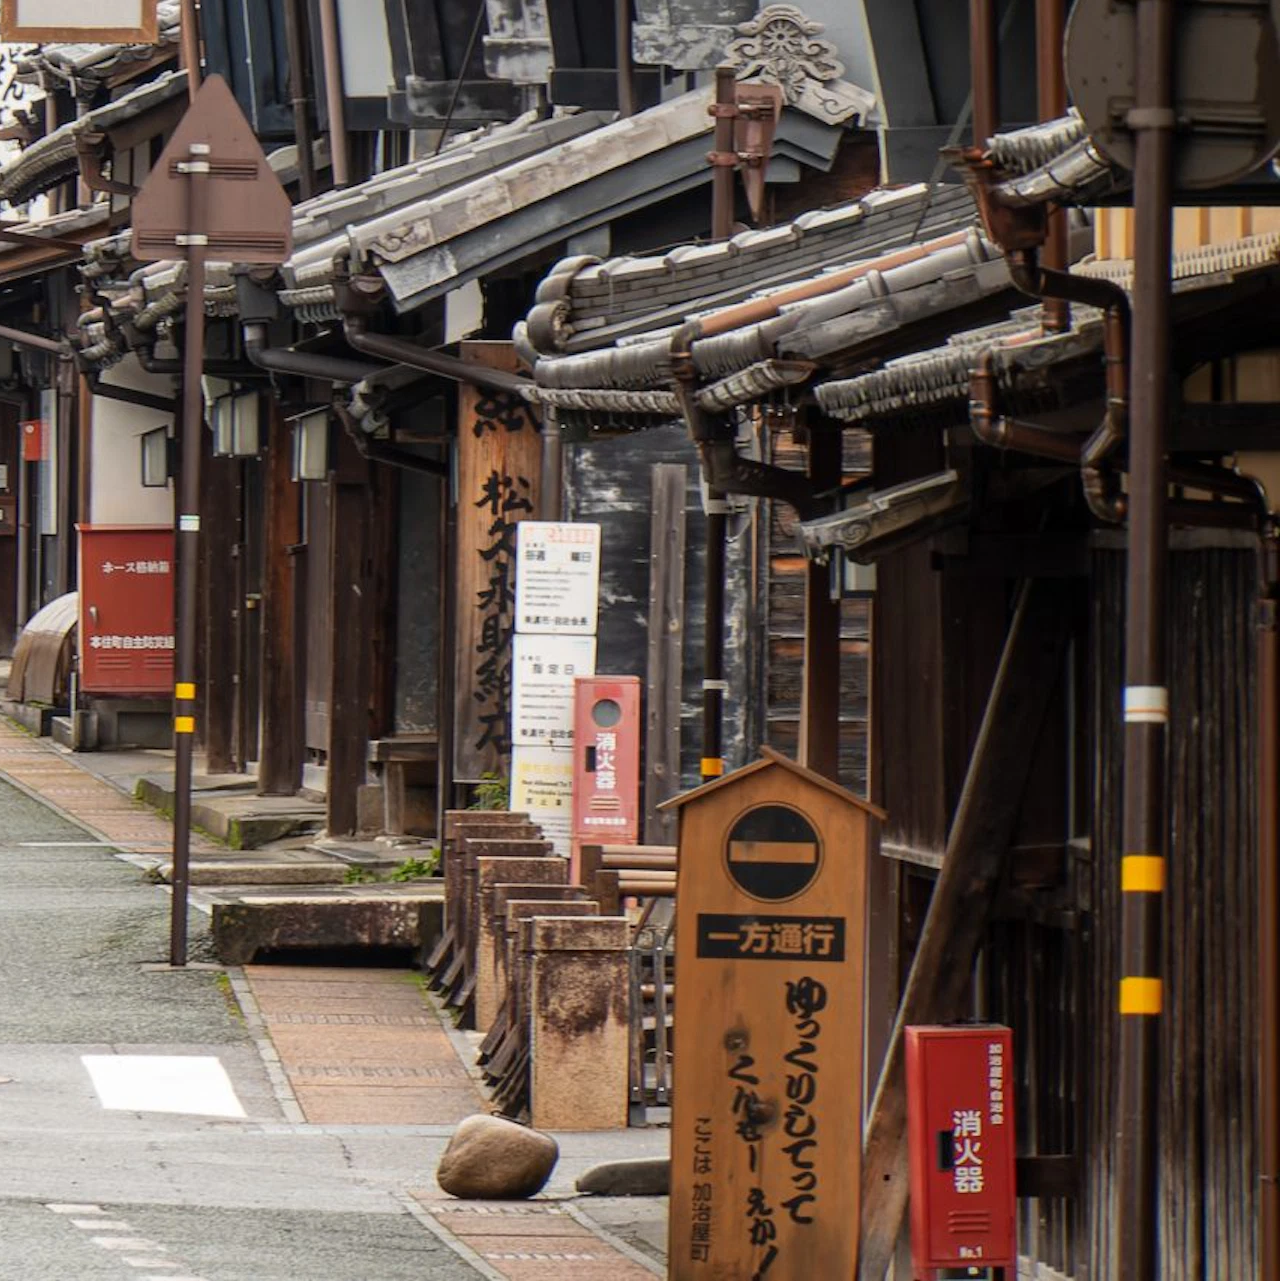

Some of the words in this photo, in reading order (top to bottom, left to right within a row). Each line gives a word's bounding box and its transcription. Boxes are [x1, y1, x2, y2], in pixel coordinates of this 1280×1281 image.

[708, 922, 835, 956] 一方通行
[781, 976, 827, 1225] ゆっくりしてって
[693, 1117, 712, 1174] ここは
[953, 1110, 984, 1193] 消火器
[691, 1183, 713, 1262] 加治屋町
